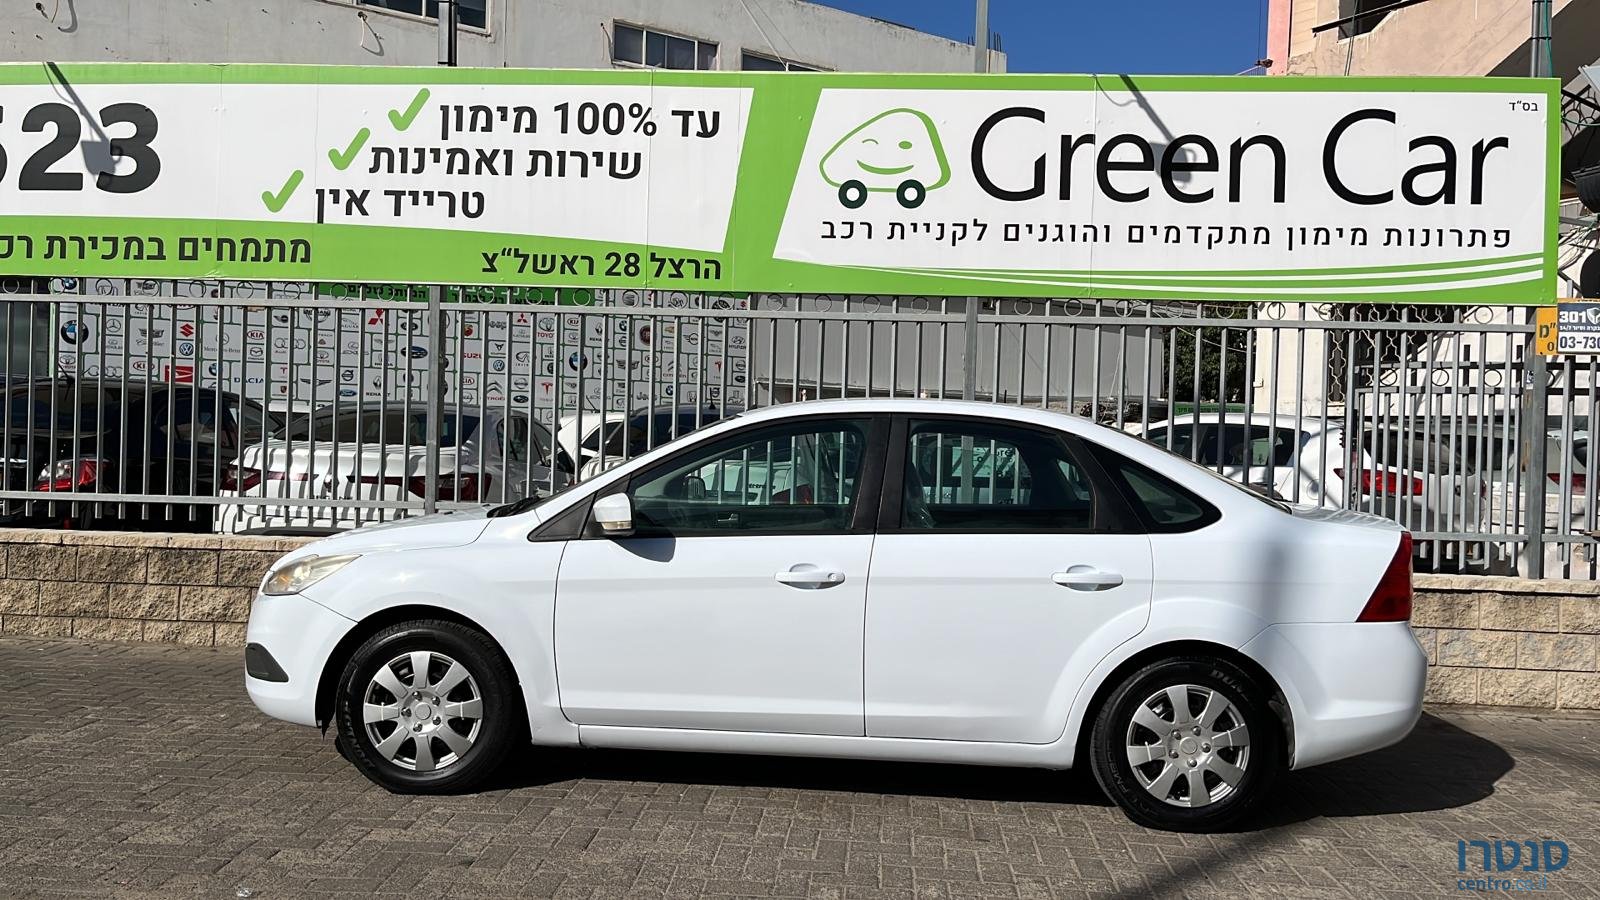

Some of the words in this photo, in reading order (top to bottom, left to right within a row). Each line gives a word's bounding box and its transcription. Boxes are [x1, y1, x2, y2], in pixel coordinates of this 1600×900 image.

[439, 104, 538, 142] מימון
[553, 102, 657, 137] 100%
[671, 109, 720, 139] עד
[0, 102, 161, 194] 23
[368, 146, 513, 176] ואמינות
[970, 106, 1287, 204] Green
[1322, 108, 1509, 206] Car
[526, 149, 642, 180] שירות
[315, 187, 369, 225] אין
[383, 189, 485, 220] טרייד
[821, 221, 873, 240] רכב
[886, 217, 988, 247] לקניית
[1003, 223, 1111, 244] והוגנים
[1127, 224, 1270, 250] מתקדמים
[1286, 226, 1368, 251] מימון
[1382, 228, 1510, 248] פתרונות
[43, 235, 167, 262] במכירת
[178, 237, 311, 264] מתמחים
[481, 247, 595, 277] ראשל"צ
[604, 251, 641, 278] 28
[649, 252, 721, 280] הרצל
[1559, 311, 1587, 324] 301
[250, 331, 264, 339] KIA
